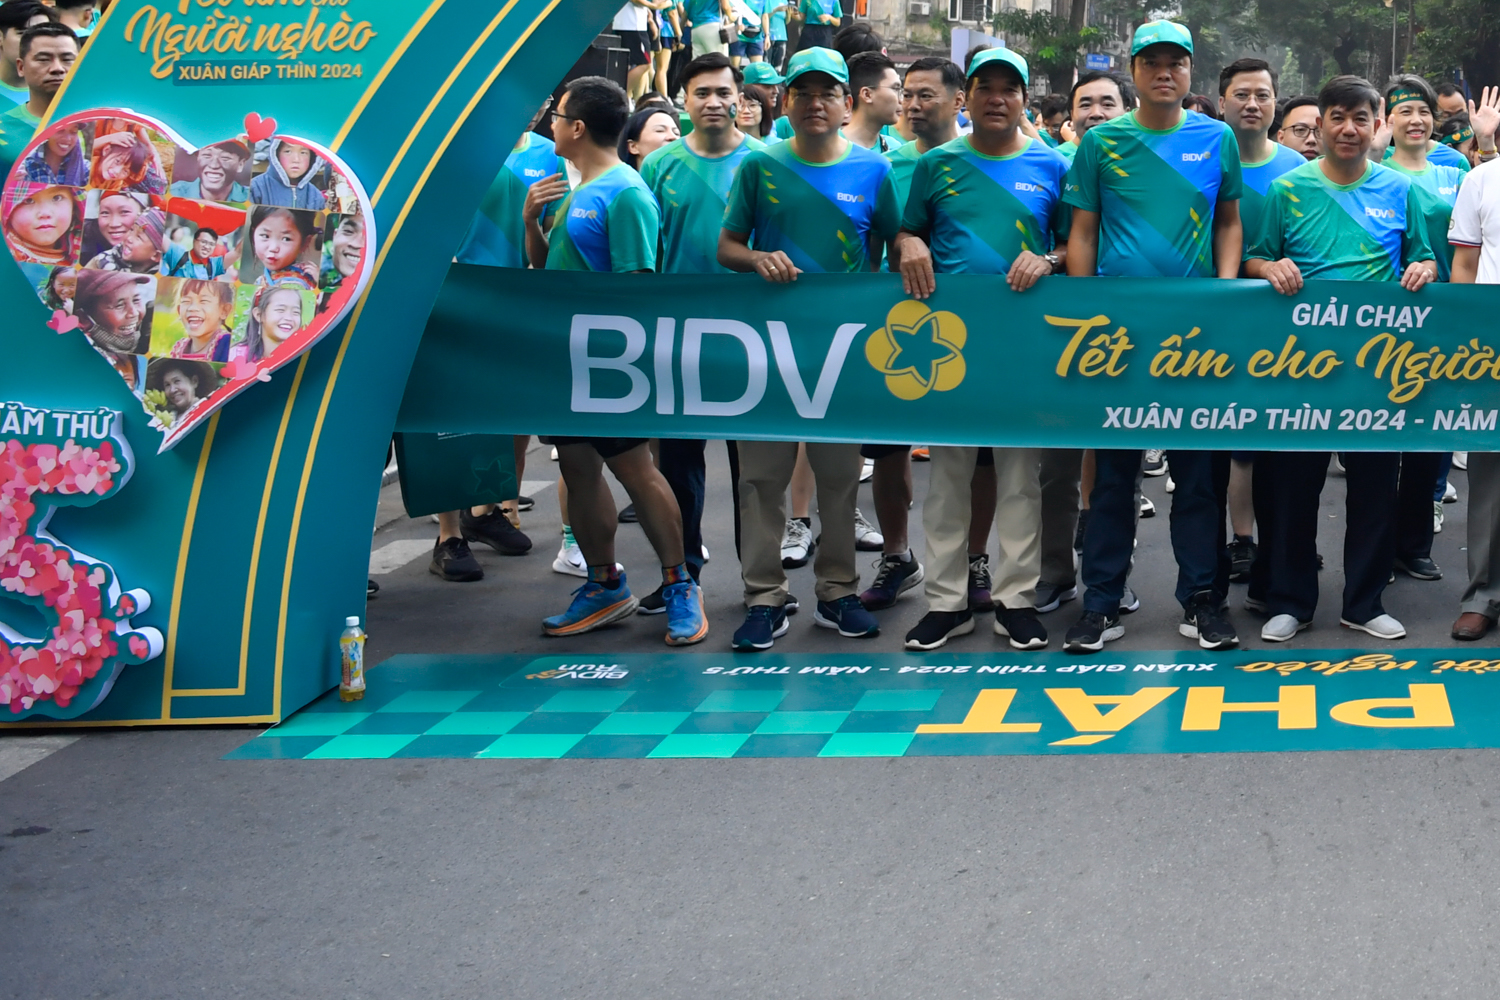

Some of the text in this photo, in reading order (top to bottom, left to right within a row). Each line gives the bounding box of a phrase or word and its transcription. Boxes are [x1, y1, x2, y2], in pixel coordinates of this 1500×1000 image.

[124, 4, 378, 80] Người nghèo
[178, 61, 363, 81] XUÂN GIÁP THÌN 2024
[1182, 153, 1204, 162] BIDV
[1015, 182, 1037, 193] BIDV
[836, 192, 858, 203] BIDV
[1365, 206, 1389, 219] BIDV
[1291, 296, 1433, 333] GIẢI CHẠY
[1043, 314, 1135, 378] Tết
[1149, 326, 1235, 378] ấm
[1247, 334, 1344, 379] cho
[569, 313, 867, 419] BIDV
[0, 404, 114, 440] ĂM THỨ
[1101, 403, 1184, 430] XUÂN
[1190, 402, 1258, 431] GIÁP
[1265, 405, 1333, 431] THÌN
[1337, 408, 1406, 431] 2024
[1432, 407, 1499, 432] NĂM
[553, 670, 630, 679] BIDV
[702, 666, 724, 675] 5
[797, 665, 872, 676] NĂM
[897, 665, 973, 674] 2024
[976, 663, 1048, 675] THÌN
[1055, 663, 1127, 674] GIÁP
[1132, 663, 1218, 674] XUÂN
[913, 682, 1455, 747] PHÁT
